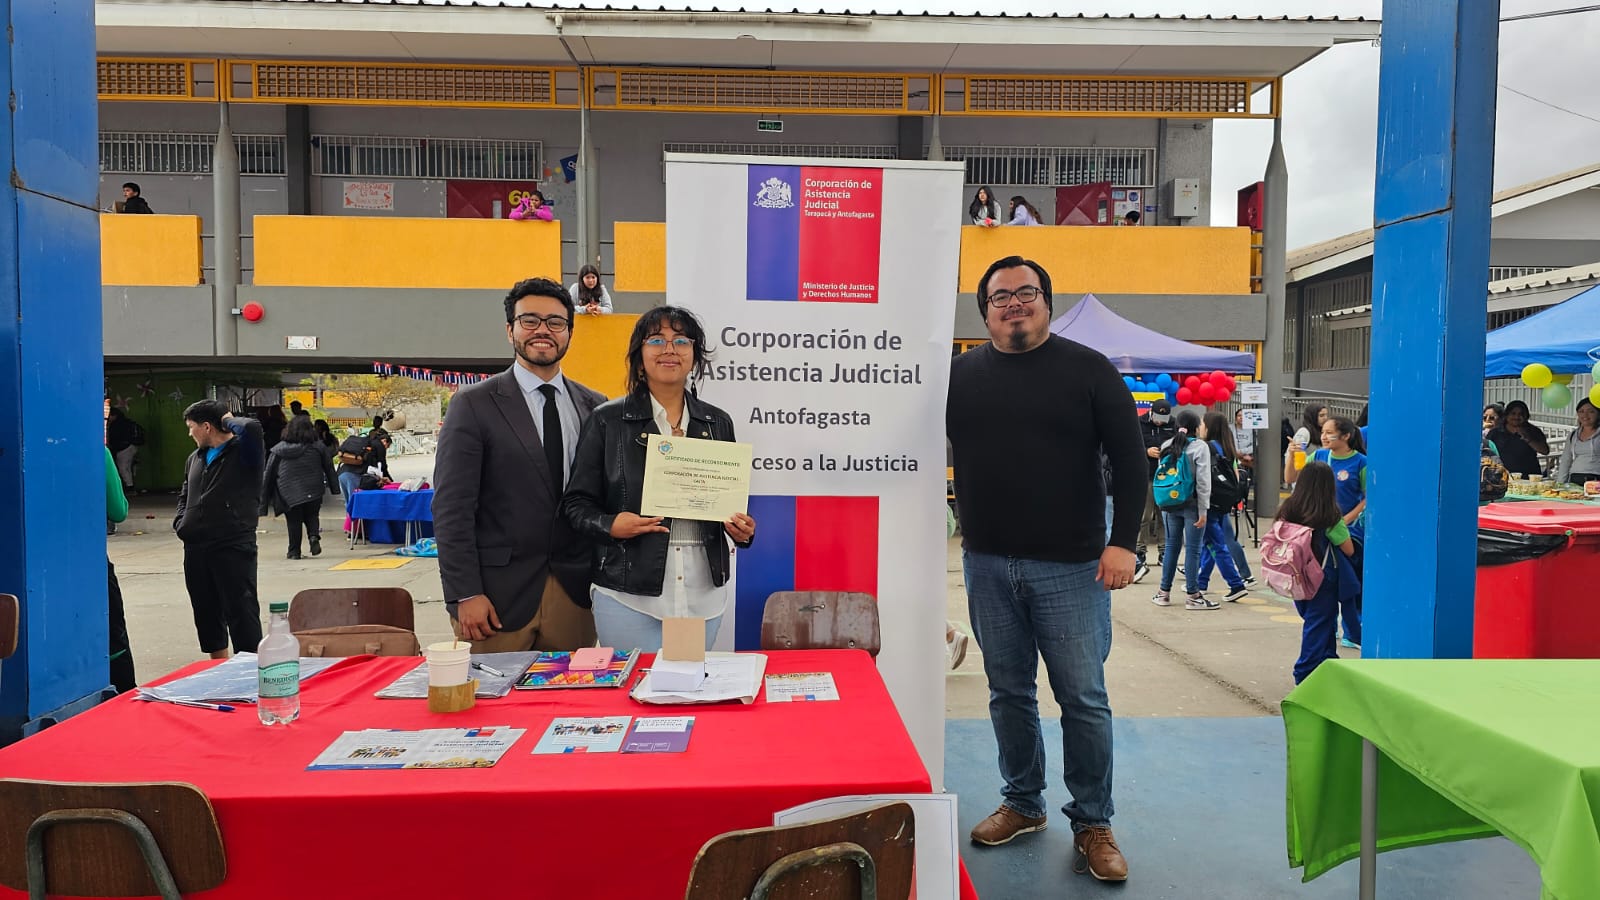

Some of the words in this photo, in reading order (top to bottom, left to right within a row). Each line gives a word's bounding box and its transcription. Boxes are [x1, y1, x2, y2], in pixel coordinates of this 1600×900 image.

[805, 178, 859, 189] Corporación
[861, 180, 872, 189] de
[805, 189, 851, 199] Asistencia
[804, 200, 839, 209] Judicial
[837, 210, 875, 219] Antofagasta
[802, 281, 838, 290] Ministerio
[839, 282, 848, 290] de
[849, 283, 875, 291] Justicia
[802, 291, 807, 299] y
[808, 290, 840, 298] Derechos
[840, 291, 872, 299] Humanos
[720, 326, 867, 353] Corporación
[873, 329, 902, 351] de
[701, 360, 823, 383] Asistencia
[829, 363, 922, 385] Judicial
[749, 407, 871, 429] Antofagasta
[752, 456, 797, 472] ceso
[802, 457, 814, 472] a
[819, 454, 837, 472] la
[842, 454, 919, 472] Justicia
